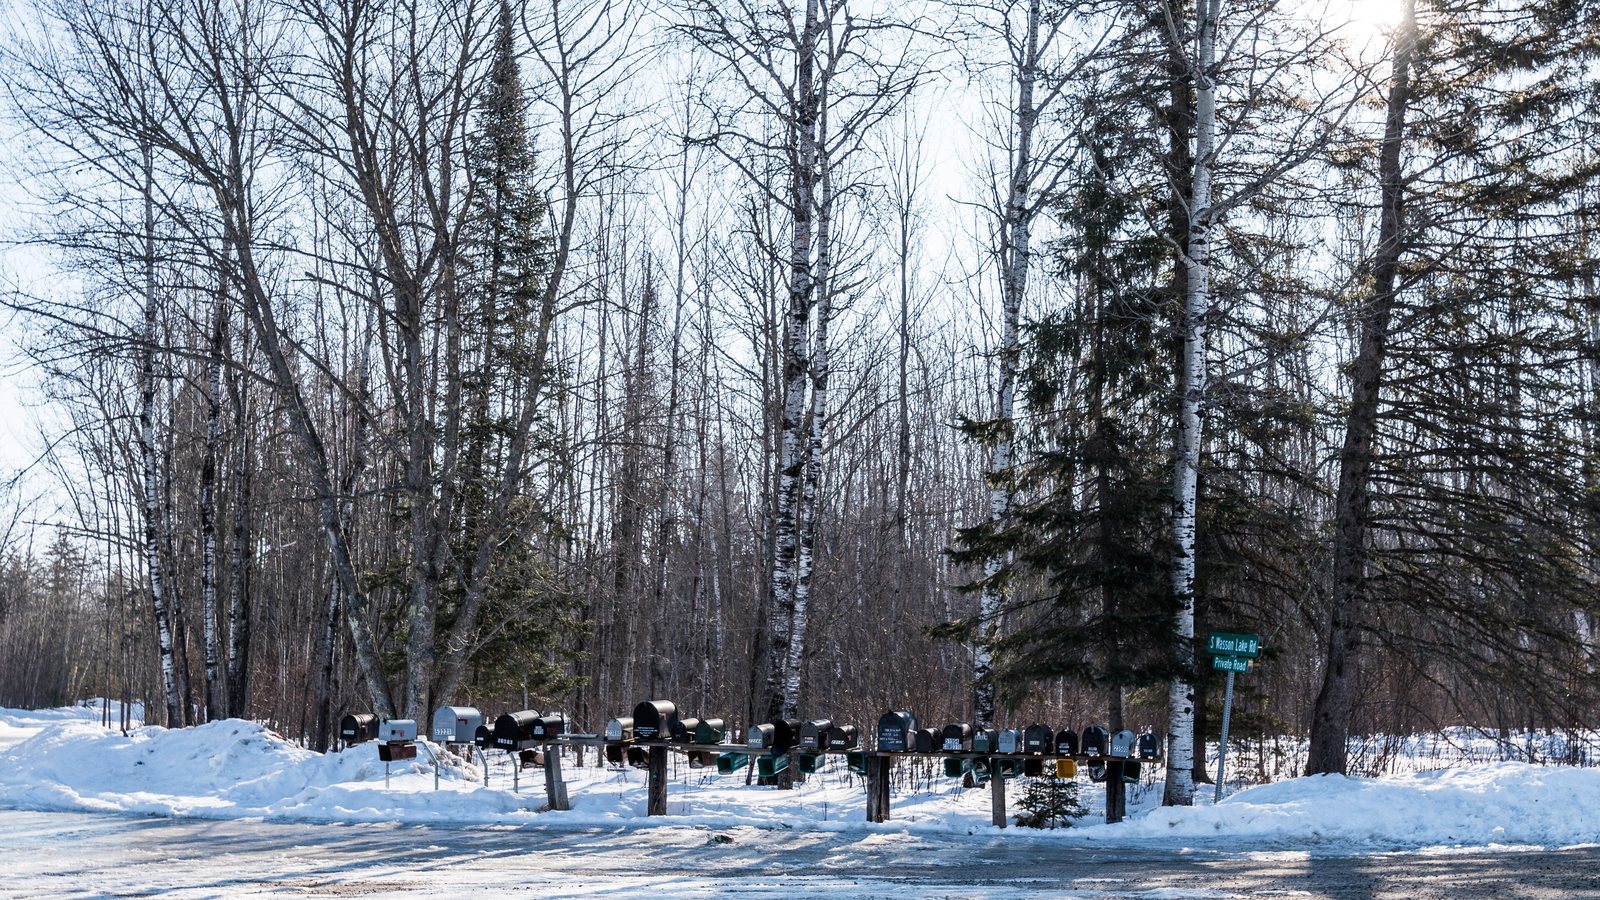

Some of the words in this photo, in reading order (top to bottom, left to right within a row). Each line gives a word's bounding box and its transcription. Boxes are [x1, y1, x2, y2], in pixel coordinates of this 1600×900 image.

[1236, 638, 1248, 652] Lake
[1248, 640, 1256, 653] Rd
[1214, 657, 1232, 669] Private
[1232, 659, 1247, 671] Road
